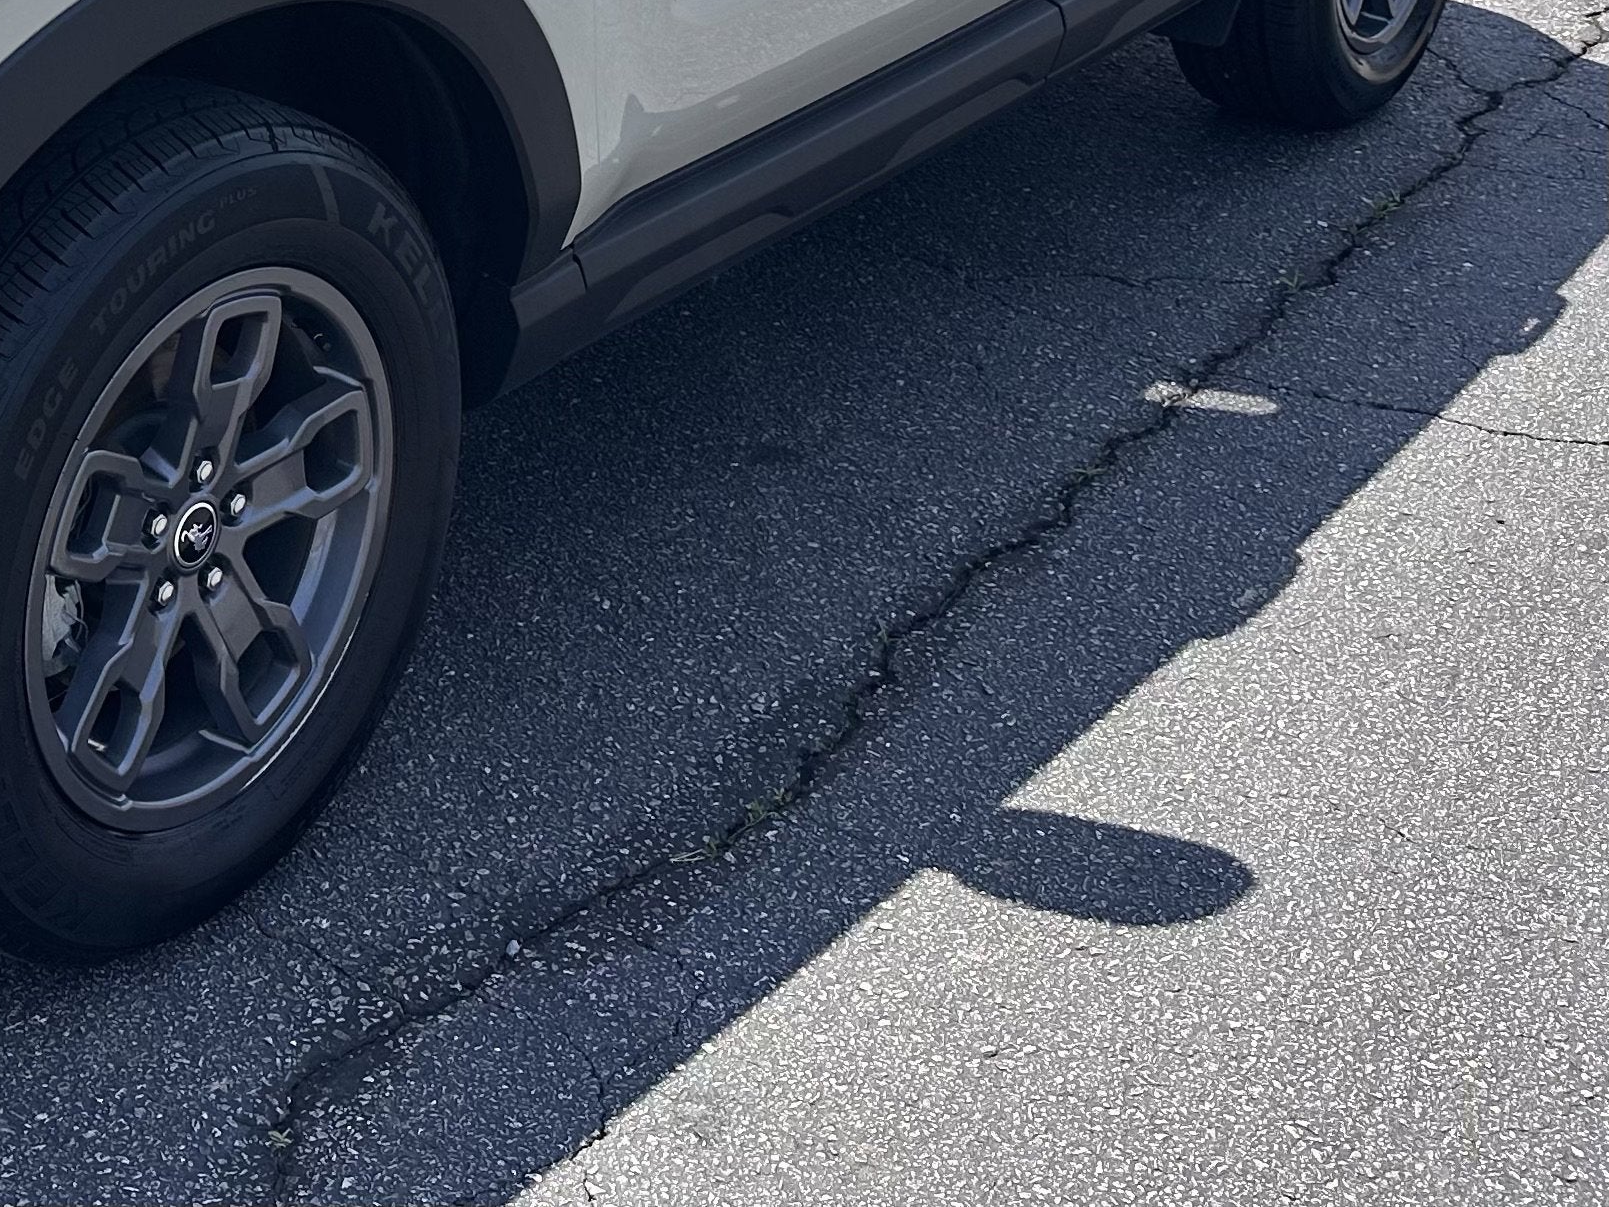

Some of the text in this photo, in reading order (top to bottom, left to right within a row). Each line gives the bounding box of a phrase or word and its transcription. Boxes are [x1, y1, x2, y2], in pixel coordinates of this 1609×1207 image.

[14, 186, 258, 481] EDGE TOURING PLUS
